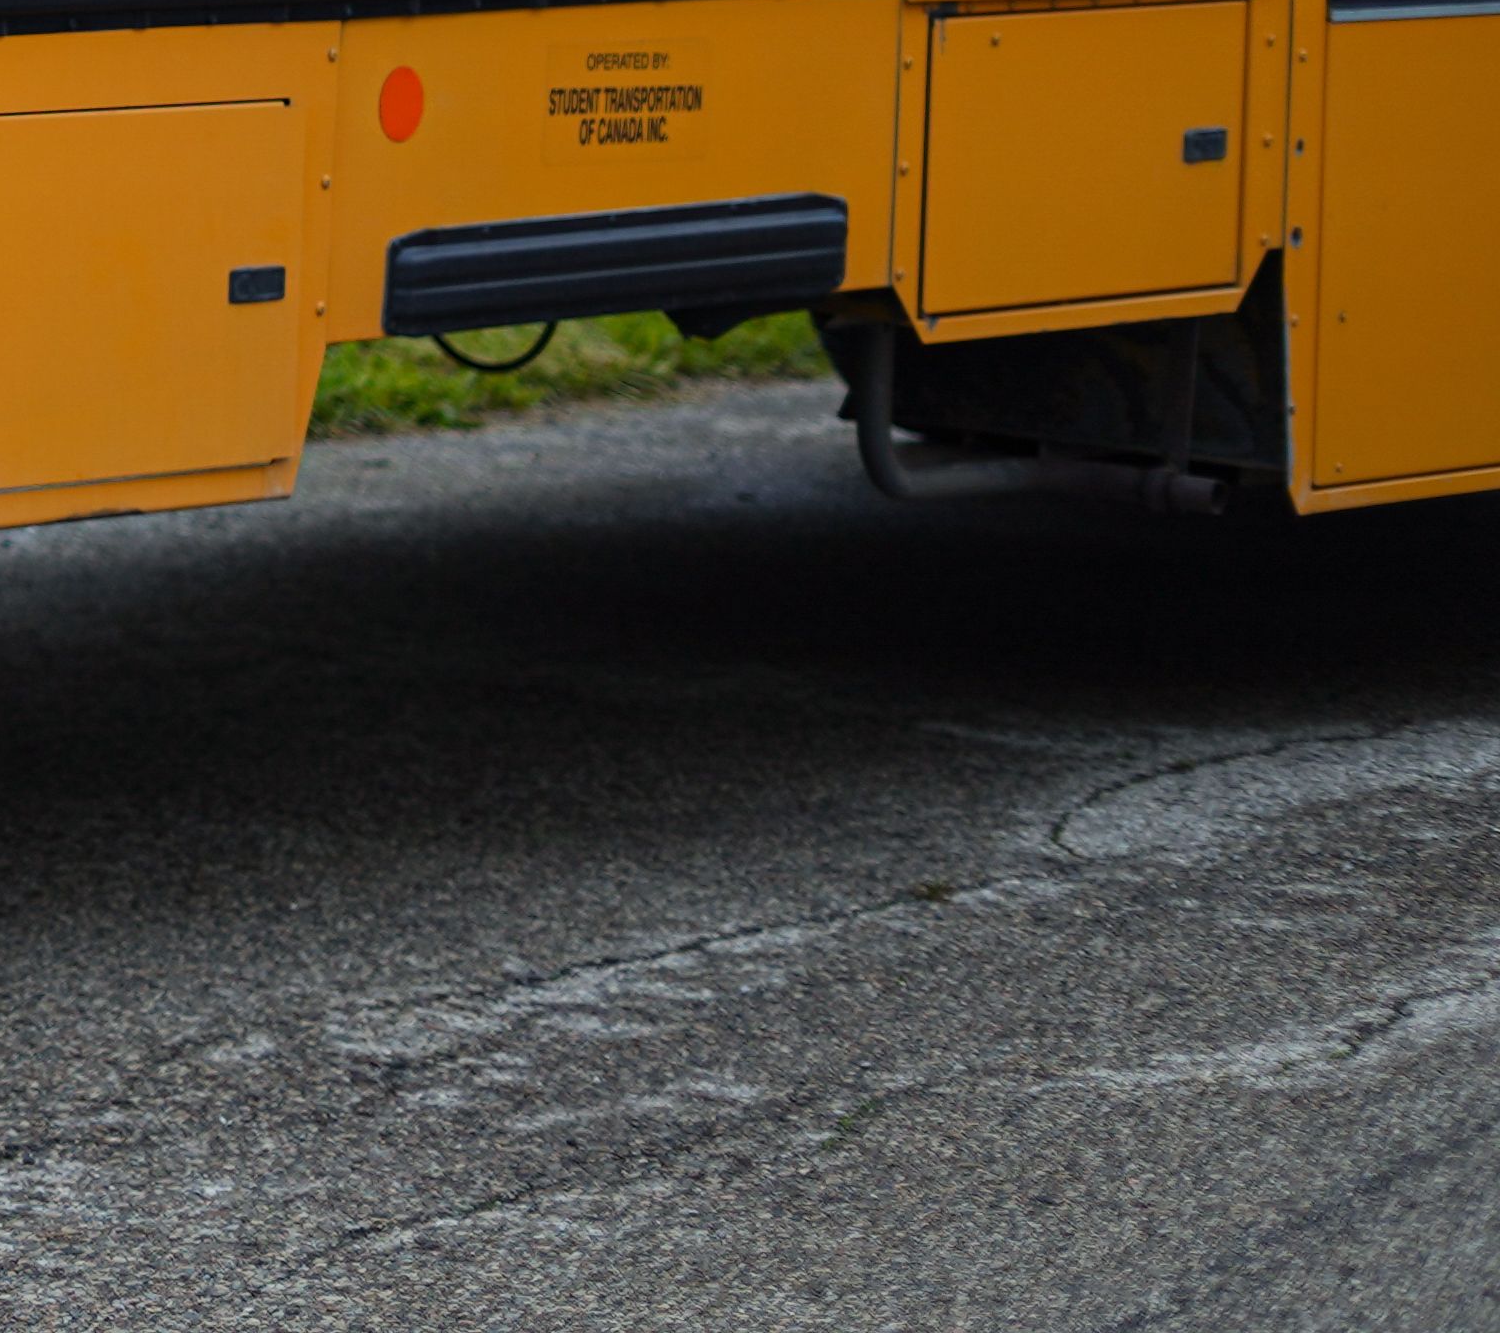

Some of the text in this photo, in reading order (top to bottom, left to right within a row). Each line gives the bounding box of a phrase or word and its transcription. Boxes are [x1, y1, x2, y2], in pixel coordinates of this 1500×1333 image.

[587, 53, 649, 71] OPERATED
[548, 84, 703, 116] STUDENT TRANSPORTATION
[579, 116, 669, 146] OF CANADA INC.
